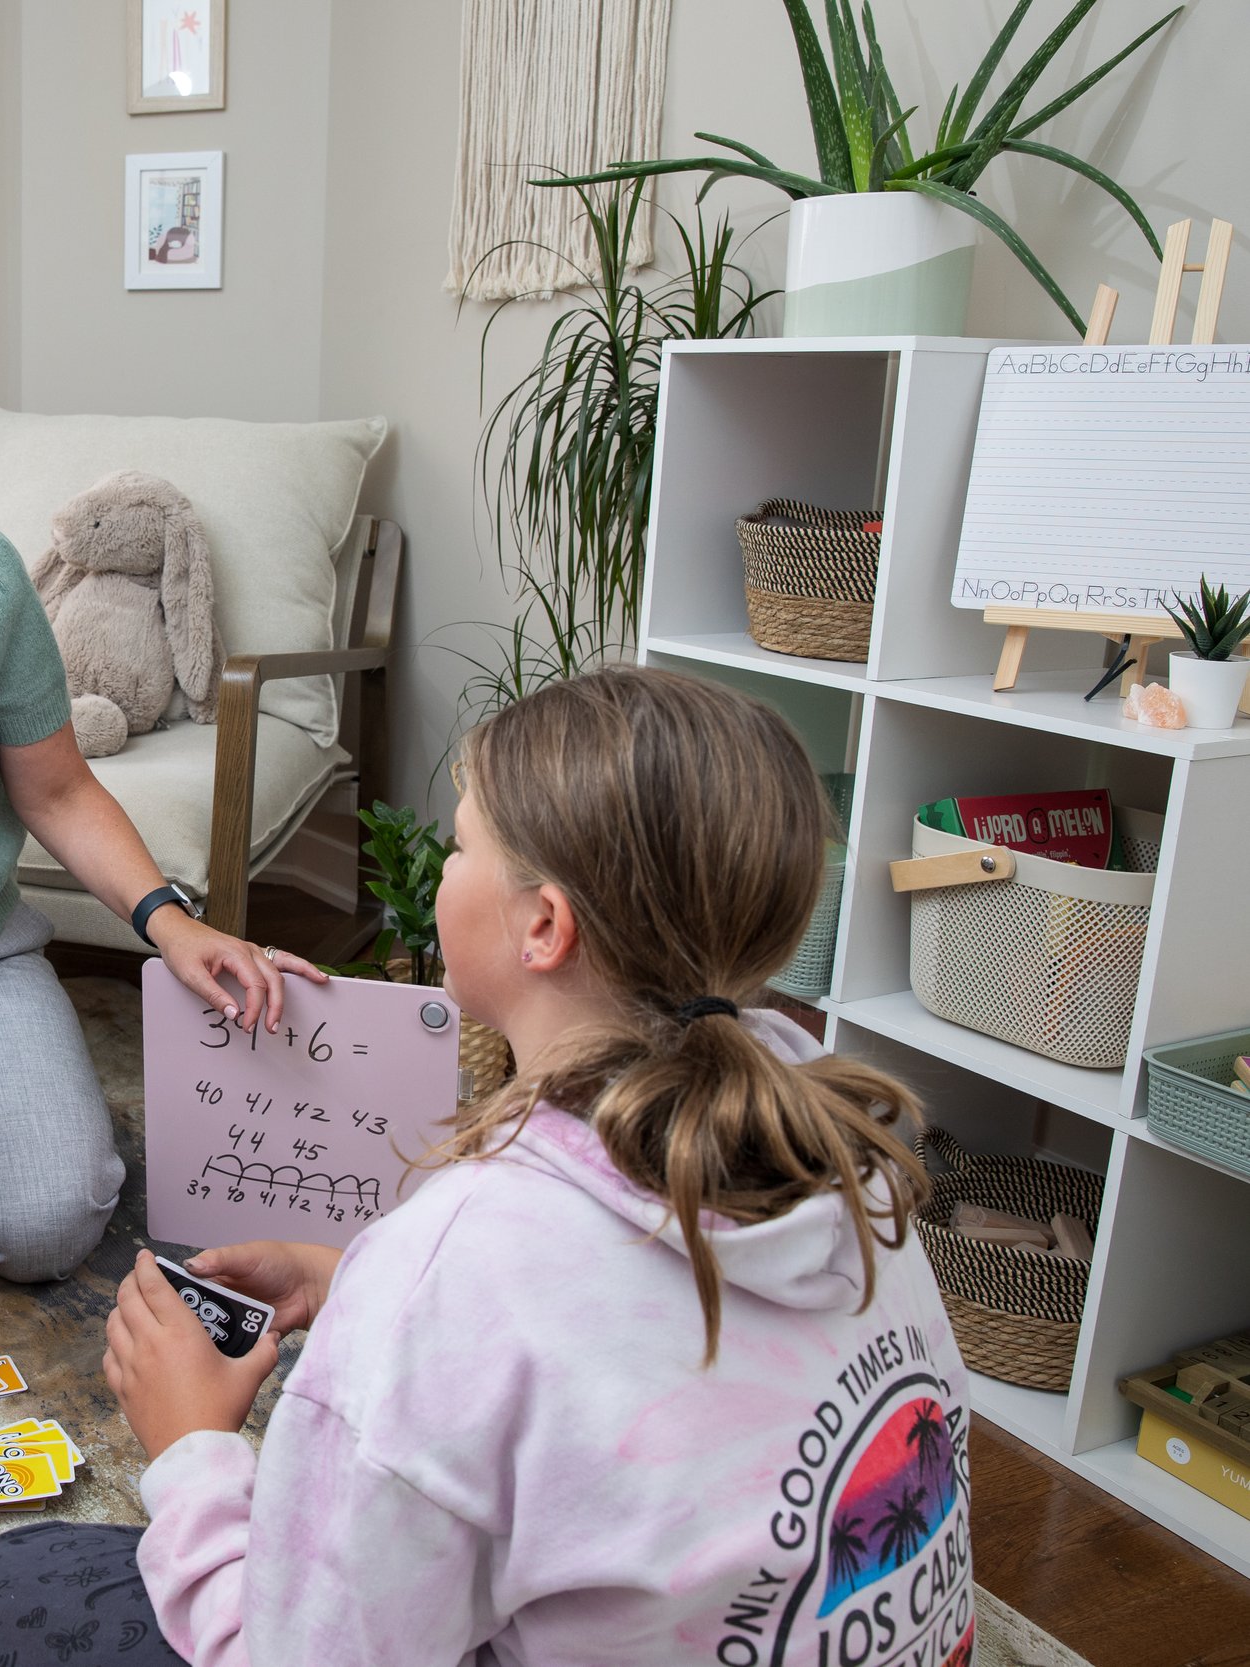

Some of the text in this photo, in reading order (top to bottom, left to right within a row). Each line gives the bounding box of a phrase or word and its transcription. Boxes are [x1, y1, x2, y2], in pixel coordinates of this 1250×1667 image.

[973, 807, 1105, 844] WORD A MELON
[308, 1021, 333, 1062] 6
[195, 1080, 388, 1135] 40 41 42 43
[228, 1123, 328, 1161] 44 45
[186, 1179, 374, 1222] 39 40 41 42 43 44
[717, 1567, 788, 1667] ONLY
[770, 1400, 844, 1551] GOOD
[837, 1330, 903, 1405] TIMES
[905, 1325, 927, 1362] IN
